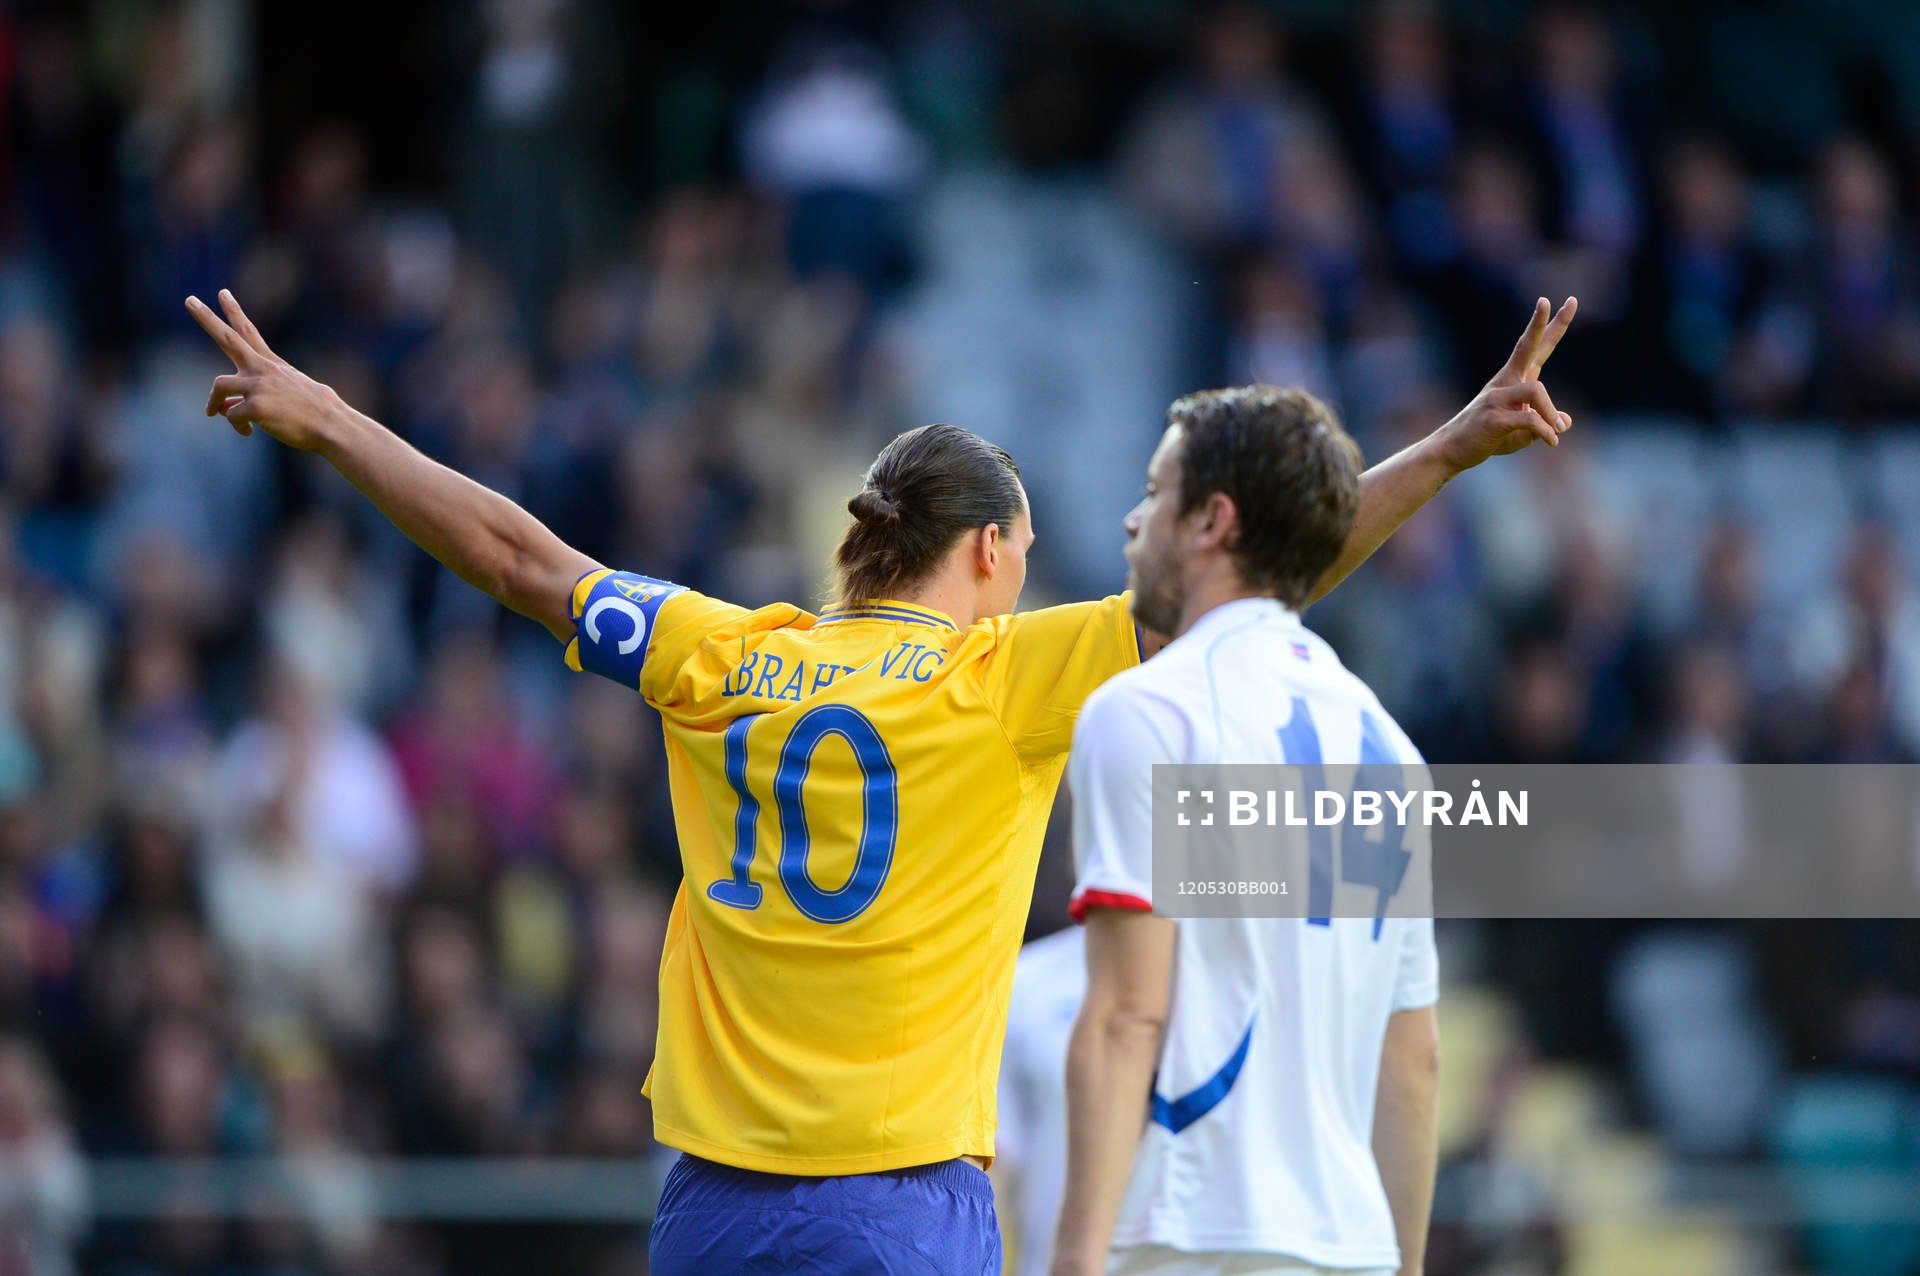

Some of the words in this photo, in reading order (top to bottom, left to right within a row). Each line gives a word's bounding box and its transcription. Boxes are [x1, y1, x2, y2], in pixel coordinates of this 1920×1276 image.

[585, 596, 646, 655] C
[707, 703, 898, 925] 10
[1276, 695, 1412, 943] 14
